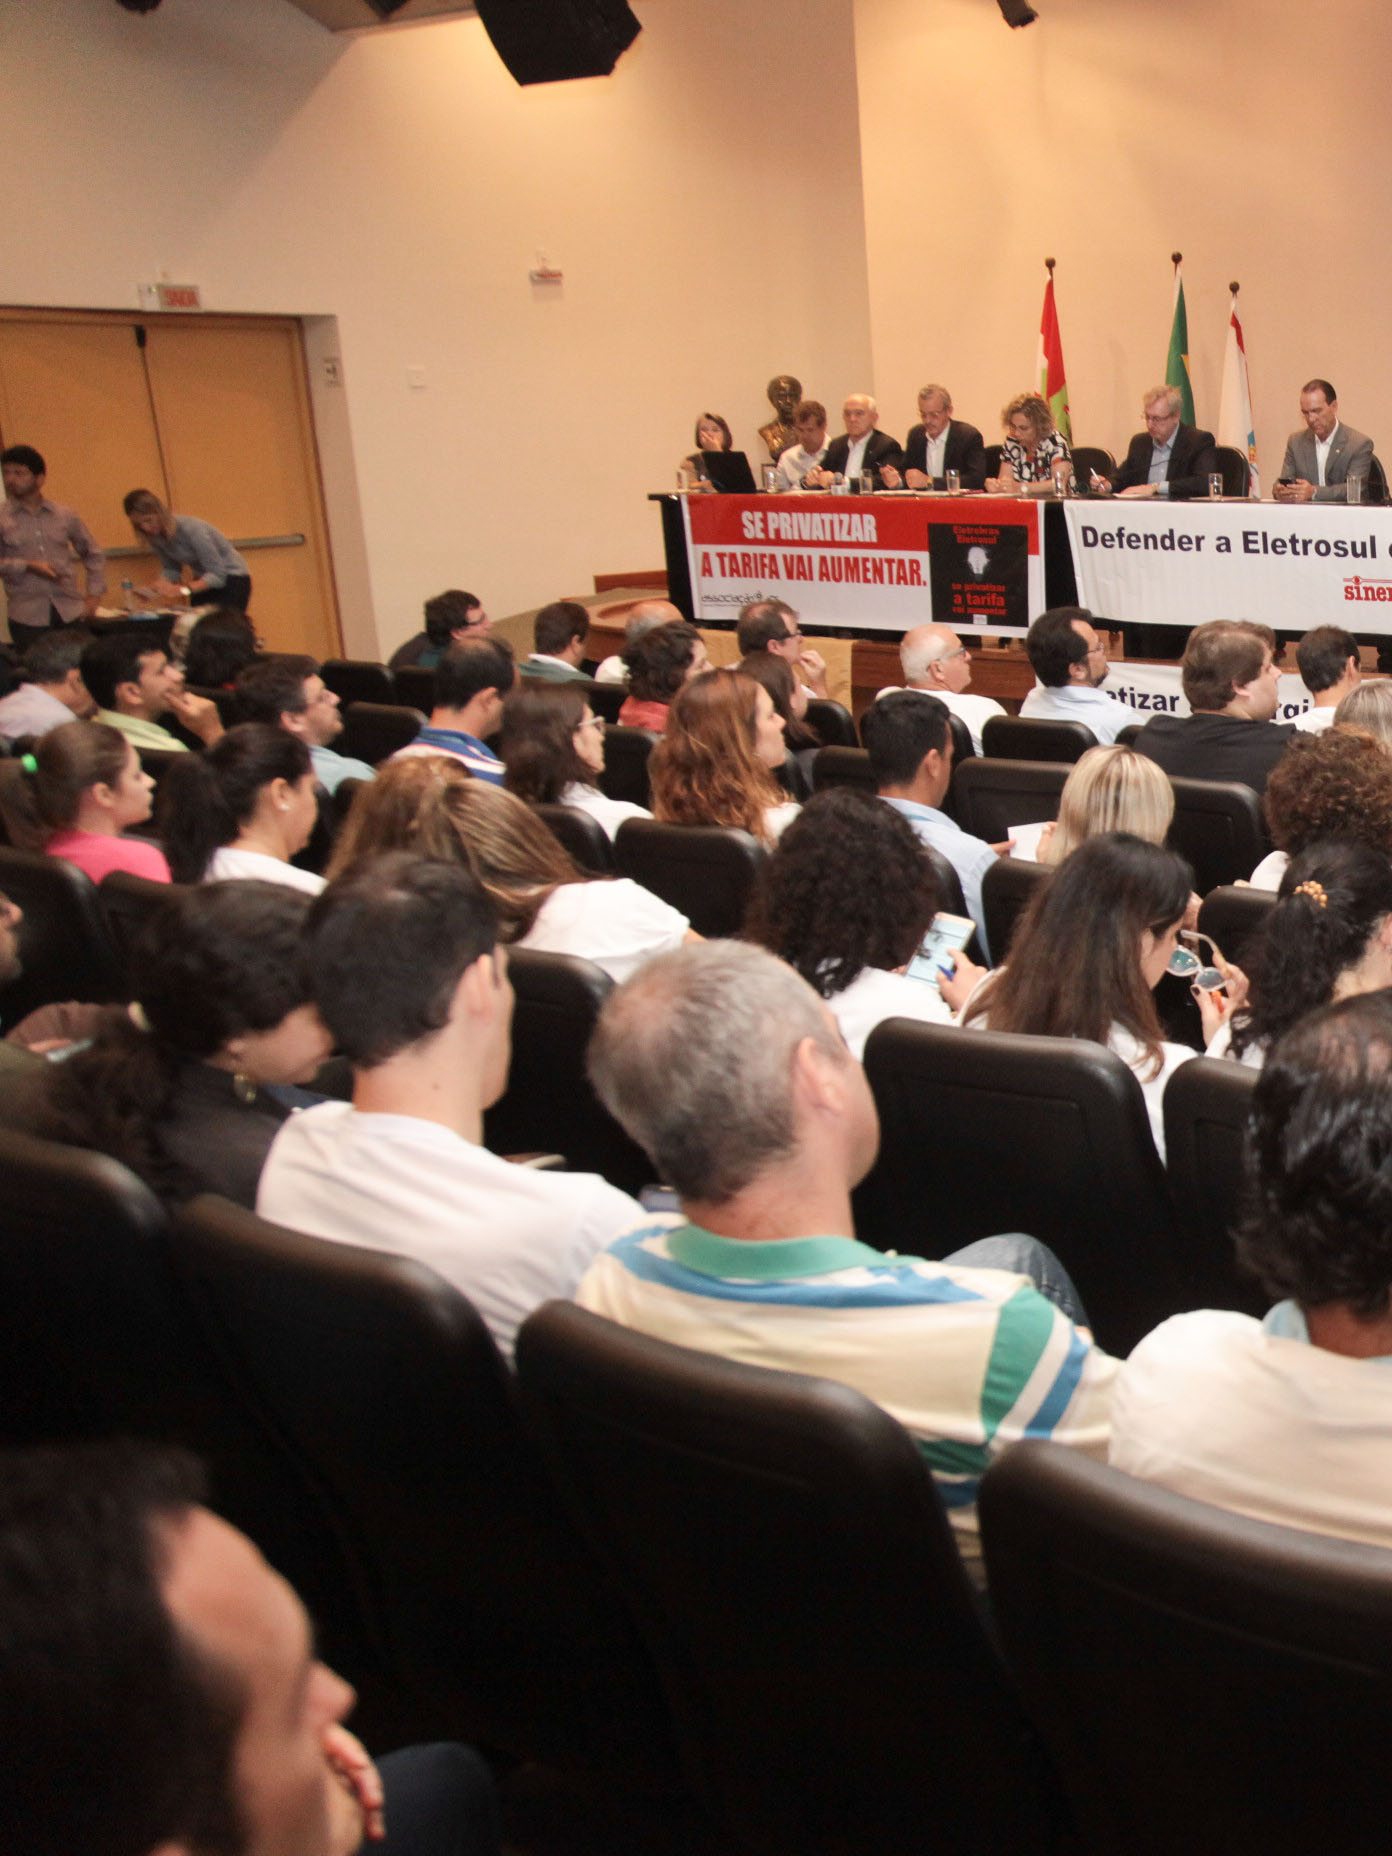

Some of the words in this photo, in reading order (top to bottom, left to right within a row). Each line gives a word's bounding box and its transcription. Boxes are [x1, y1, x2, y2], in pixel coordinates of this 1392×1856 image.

[742, 510, 765, 539] SE
[767, 512, 878, 543] PRIVATIZAR
[1081, 525, 1206, 553] Defender
[1215, 534, 1232, 553] a
[1242, 530, 1377, 559] Eletrosul
[701, 552, 713, 577] A
[716, 552, 779, 580] TARIFA
[782, 555, 814, 582] VAI
[818, 556, 927, 587] AUMENTAR.
[953, 594, 962, 604] a
[966, 592, 1005, 606] tarifa
